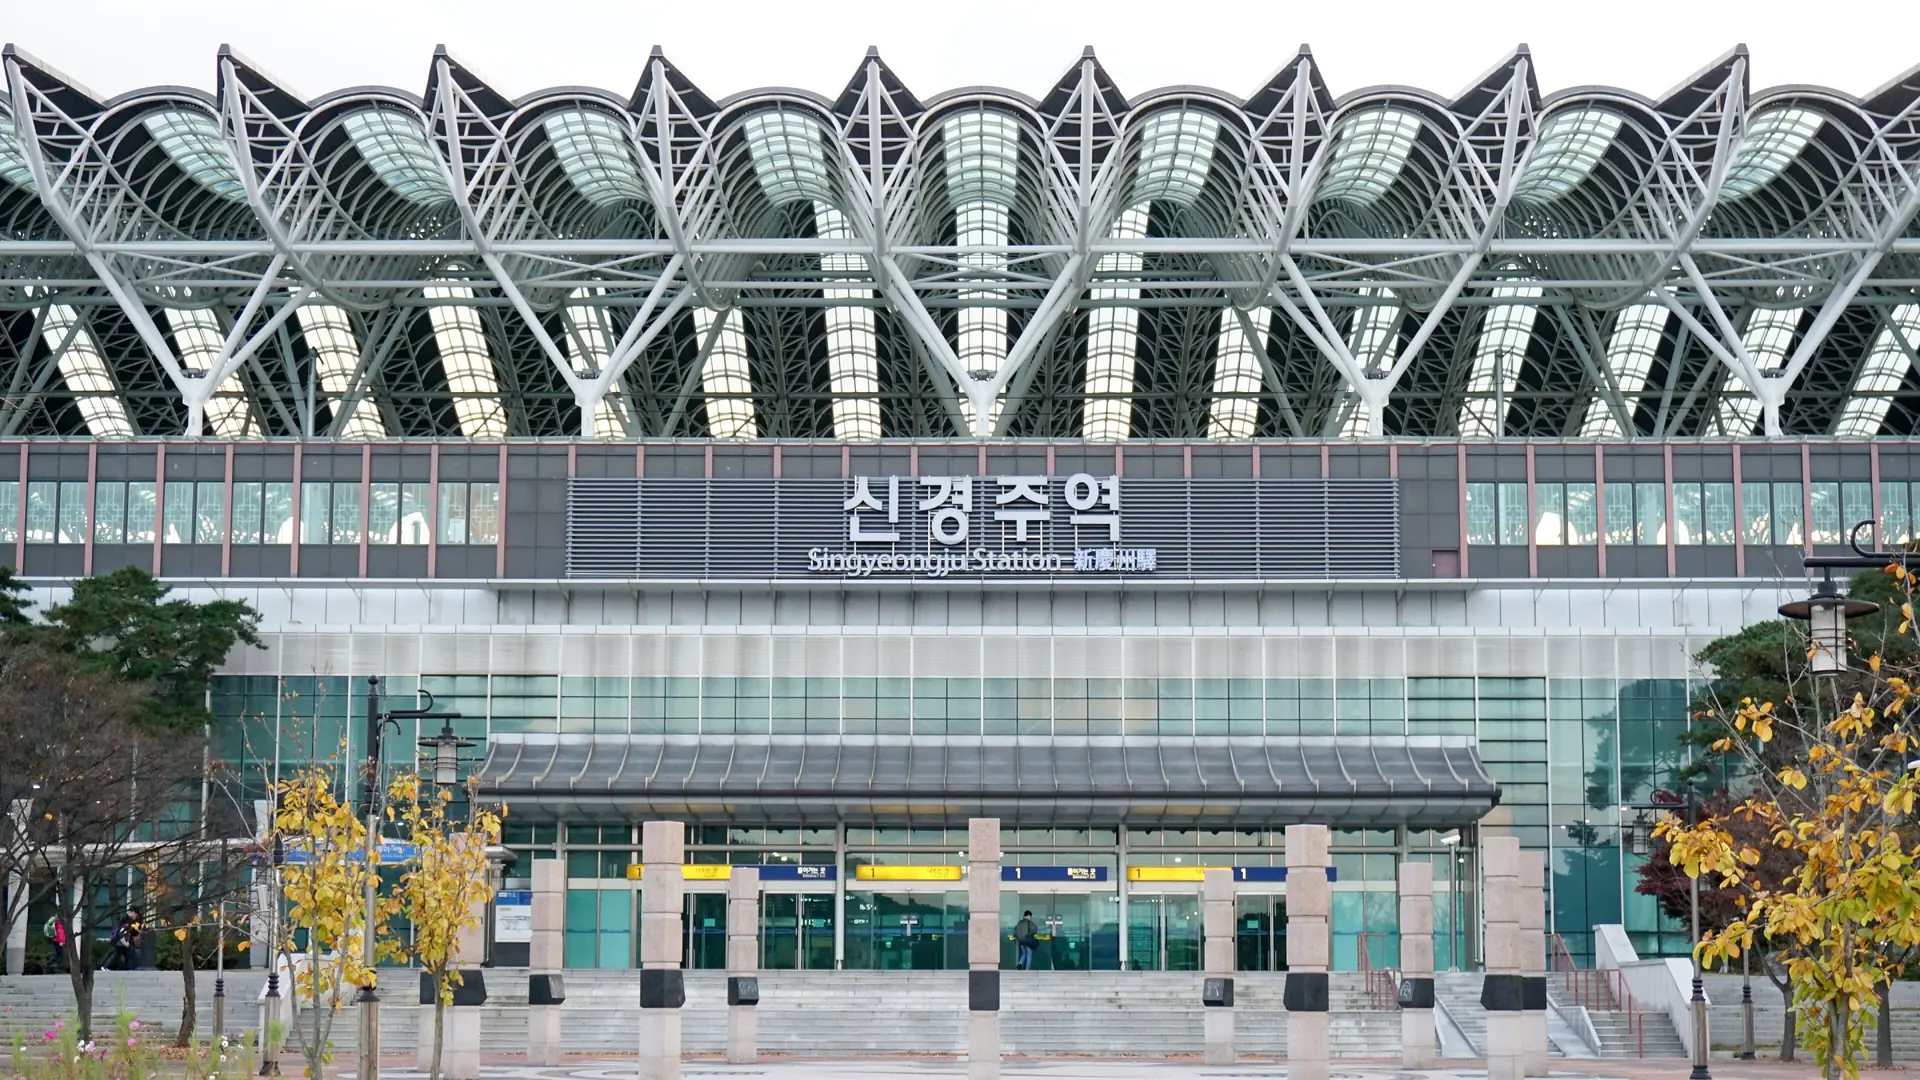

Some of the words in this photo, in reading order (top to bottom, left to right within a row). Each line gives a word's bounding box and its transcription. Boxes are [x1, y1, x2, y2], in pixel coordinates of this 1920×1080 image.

[844, 473, 1120, 545] 신경주역
[808, 547, 967, 577] Singyeongju
[972, 547, 1061, 571] Station
[1073, 547, 1157, 571] 新慶州驛
[637, 867, 641, 878] 1
[870, 867, 875, 879] 1
[1015, 867, 1021, 879] 1
[1136, 868, 1141, 879] 1
[1240, 867, 1247, 880] 1
